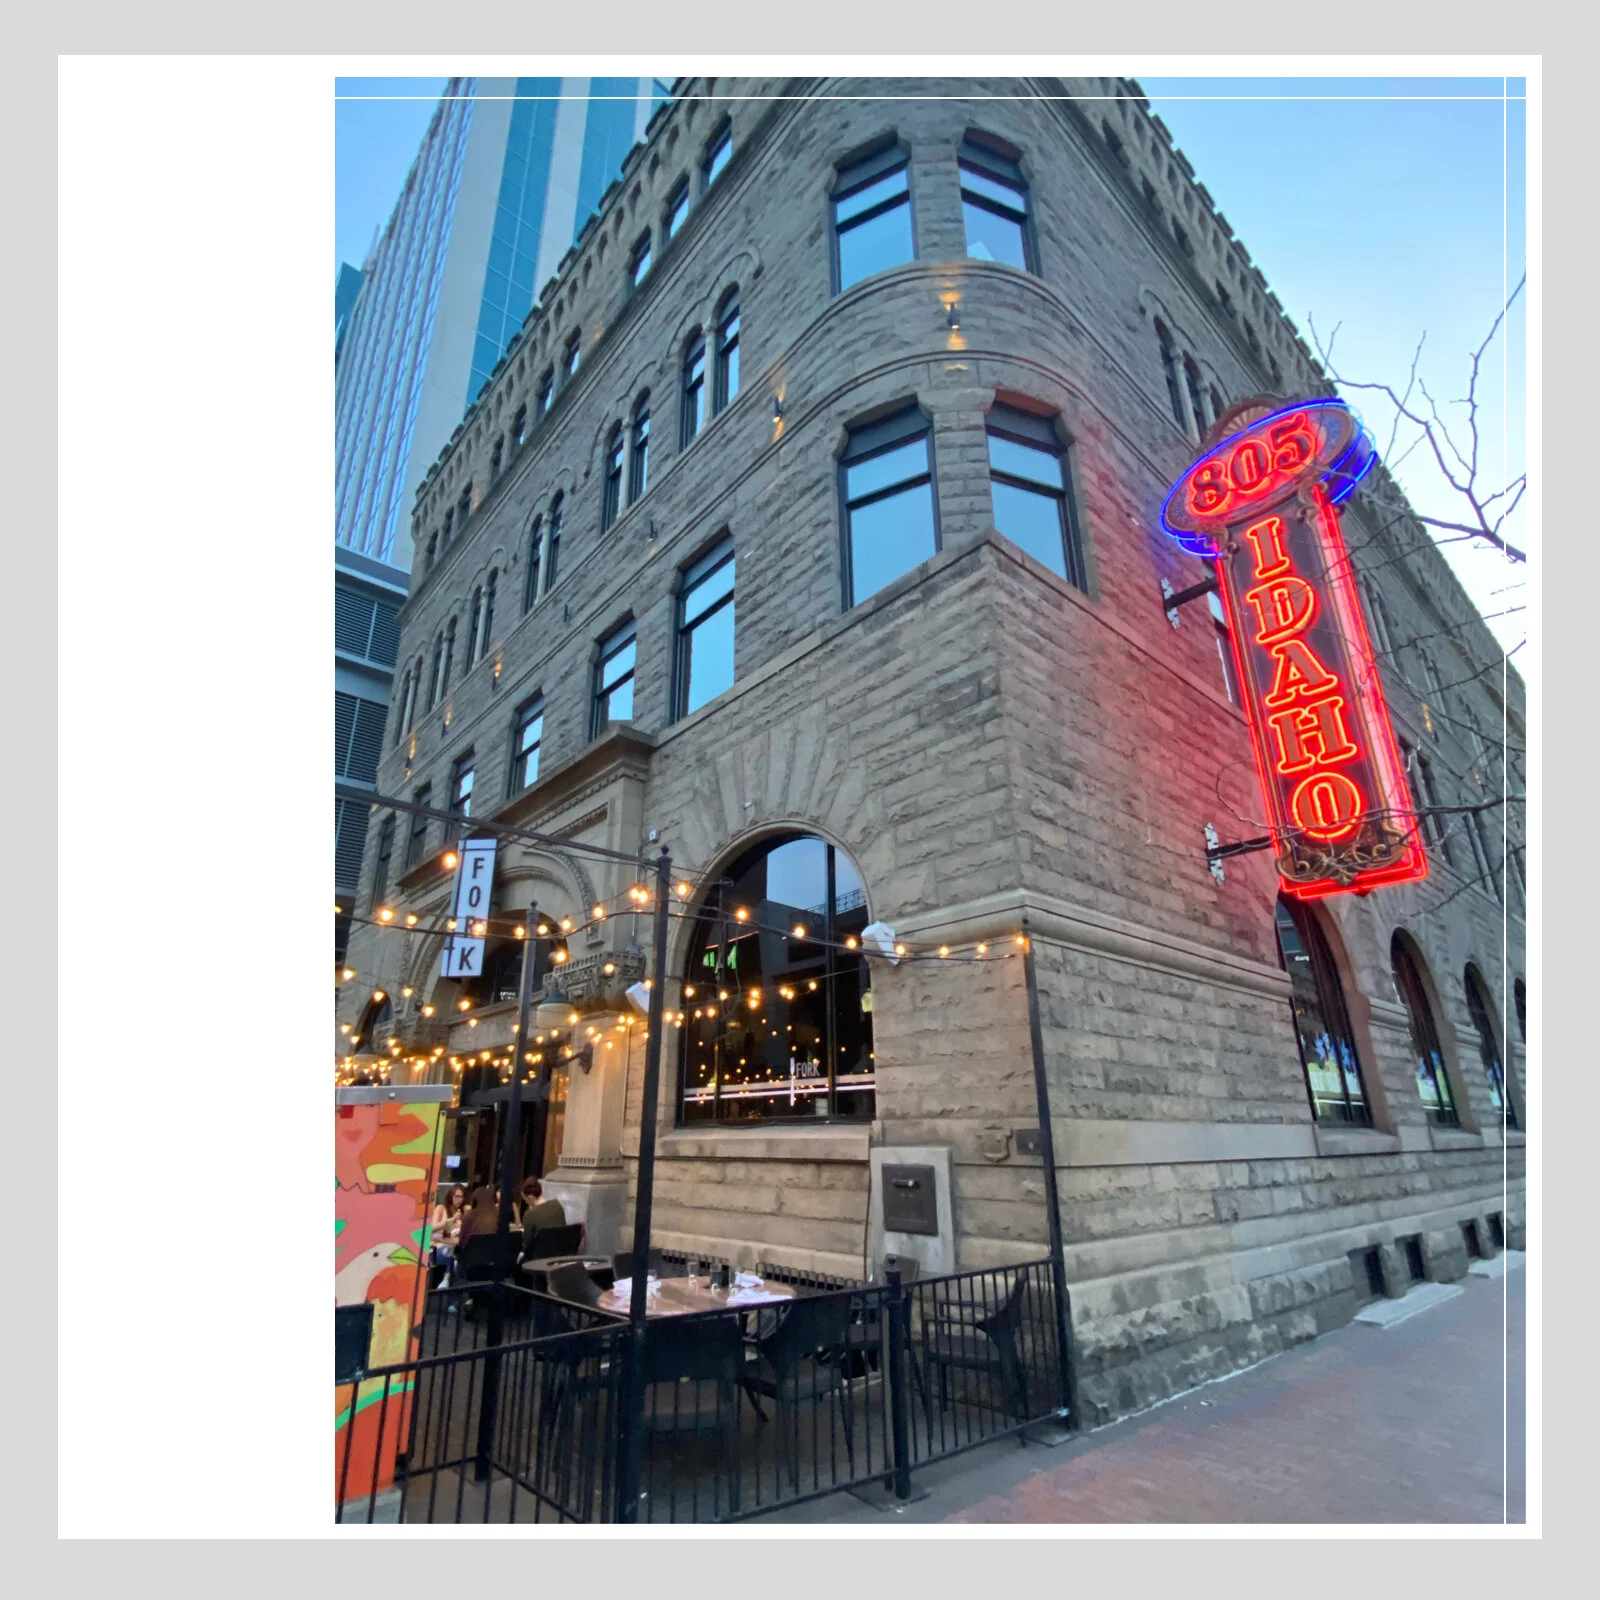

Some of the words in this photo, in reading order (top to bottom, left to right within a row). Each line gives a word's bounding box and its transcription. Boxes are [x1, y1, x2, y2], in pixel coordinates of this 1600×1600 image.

[1187, 411, 1317, 517] 805
[1245, 515, 1362, 840] IDAHO
[458, 857, 485, 971] FORK
[796, 1061, 820, 1078] FORK
